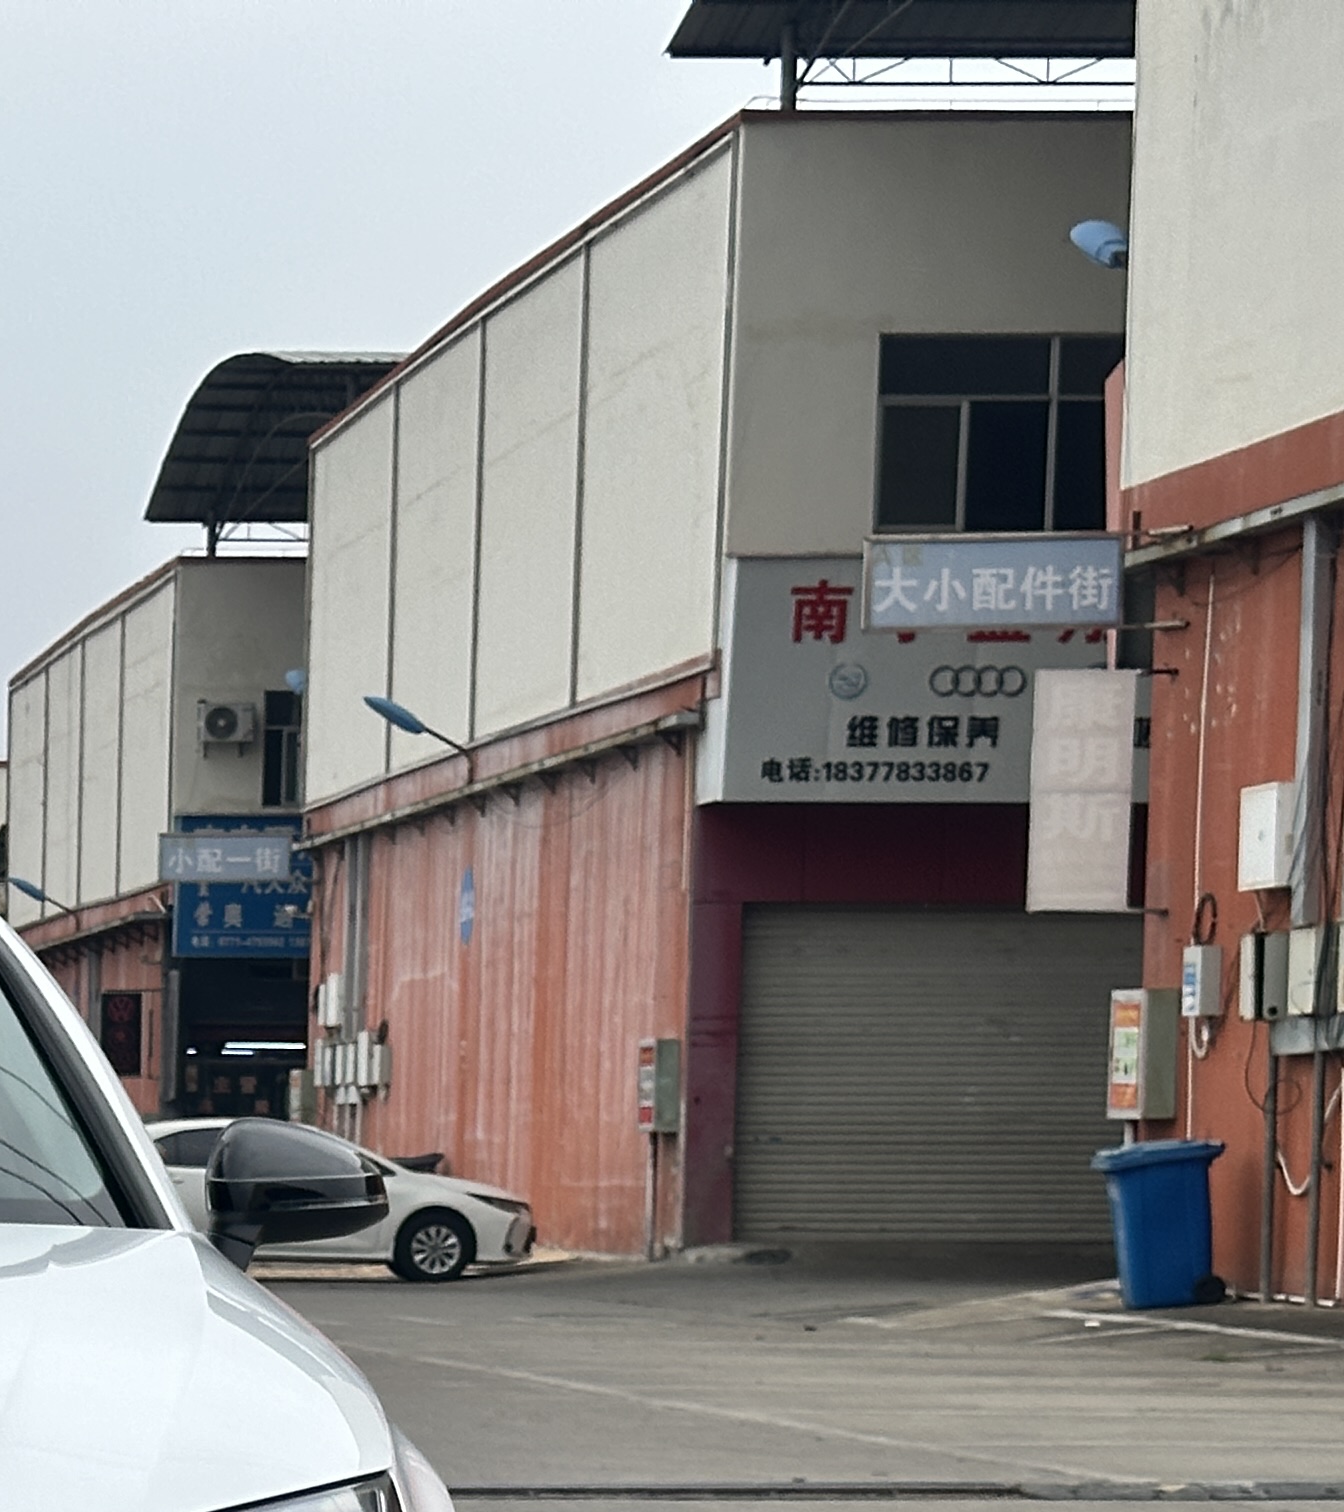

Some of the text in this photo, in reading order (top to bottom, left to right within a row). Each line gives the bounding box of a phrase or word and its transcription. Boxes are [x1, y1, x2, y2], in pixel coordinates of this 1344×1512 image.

[872, 564, 1112, 613] 大小配件街
[846, 715, 1000, 748] 维修保养
[168, 846, 282, 874] 小配一街
